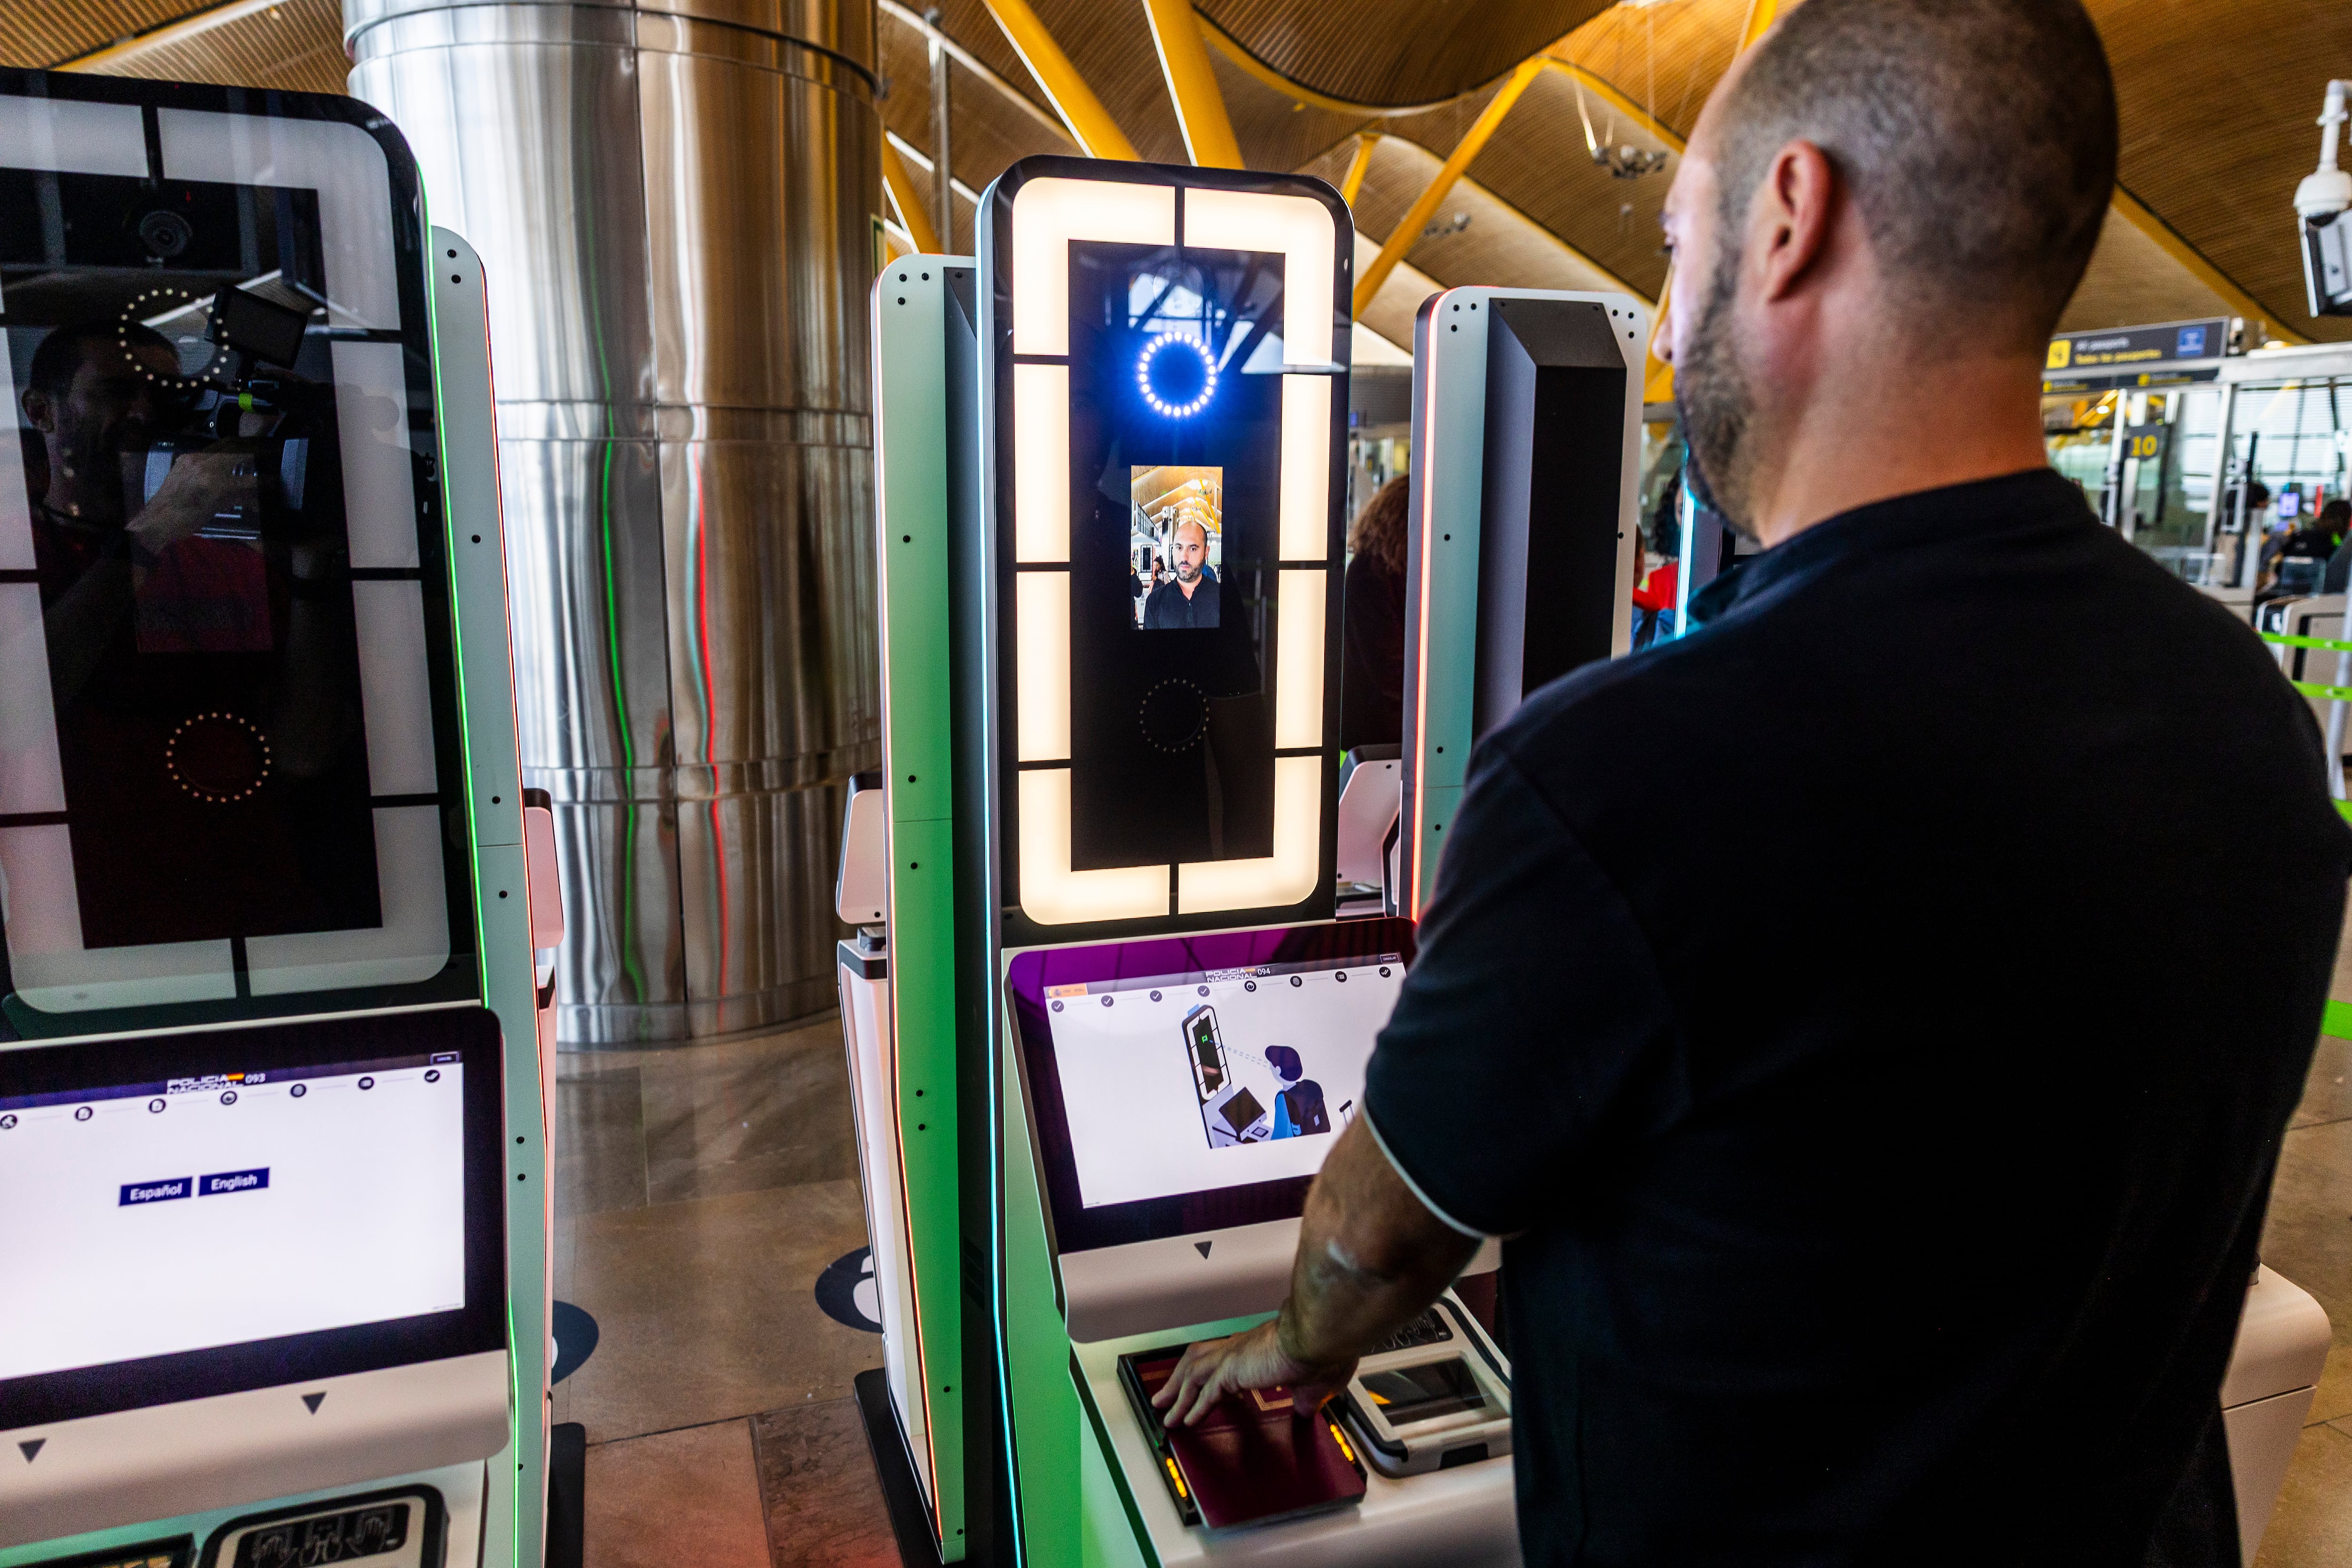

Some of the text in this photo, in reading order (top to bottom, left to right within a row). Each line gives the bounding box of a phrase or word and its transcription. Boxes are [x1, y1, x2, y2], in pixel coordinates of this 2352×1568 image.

[2131, 435, 2157, 456] 10
[1205, 968, 1246, 977] POLICIA
[1207, 973, 1257, 983] NACIONAL
[245, 1073, 266, 1084] 093
[211, 1174, 257, 1191] English
[130, 1182, 183, 1201] Español
